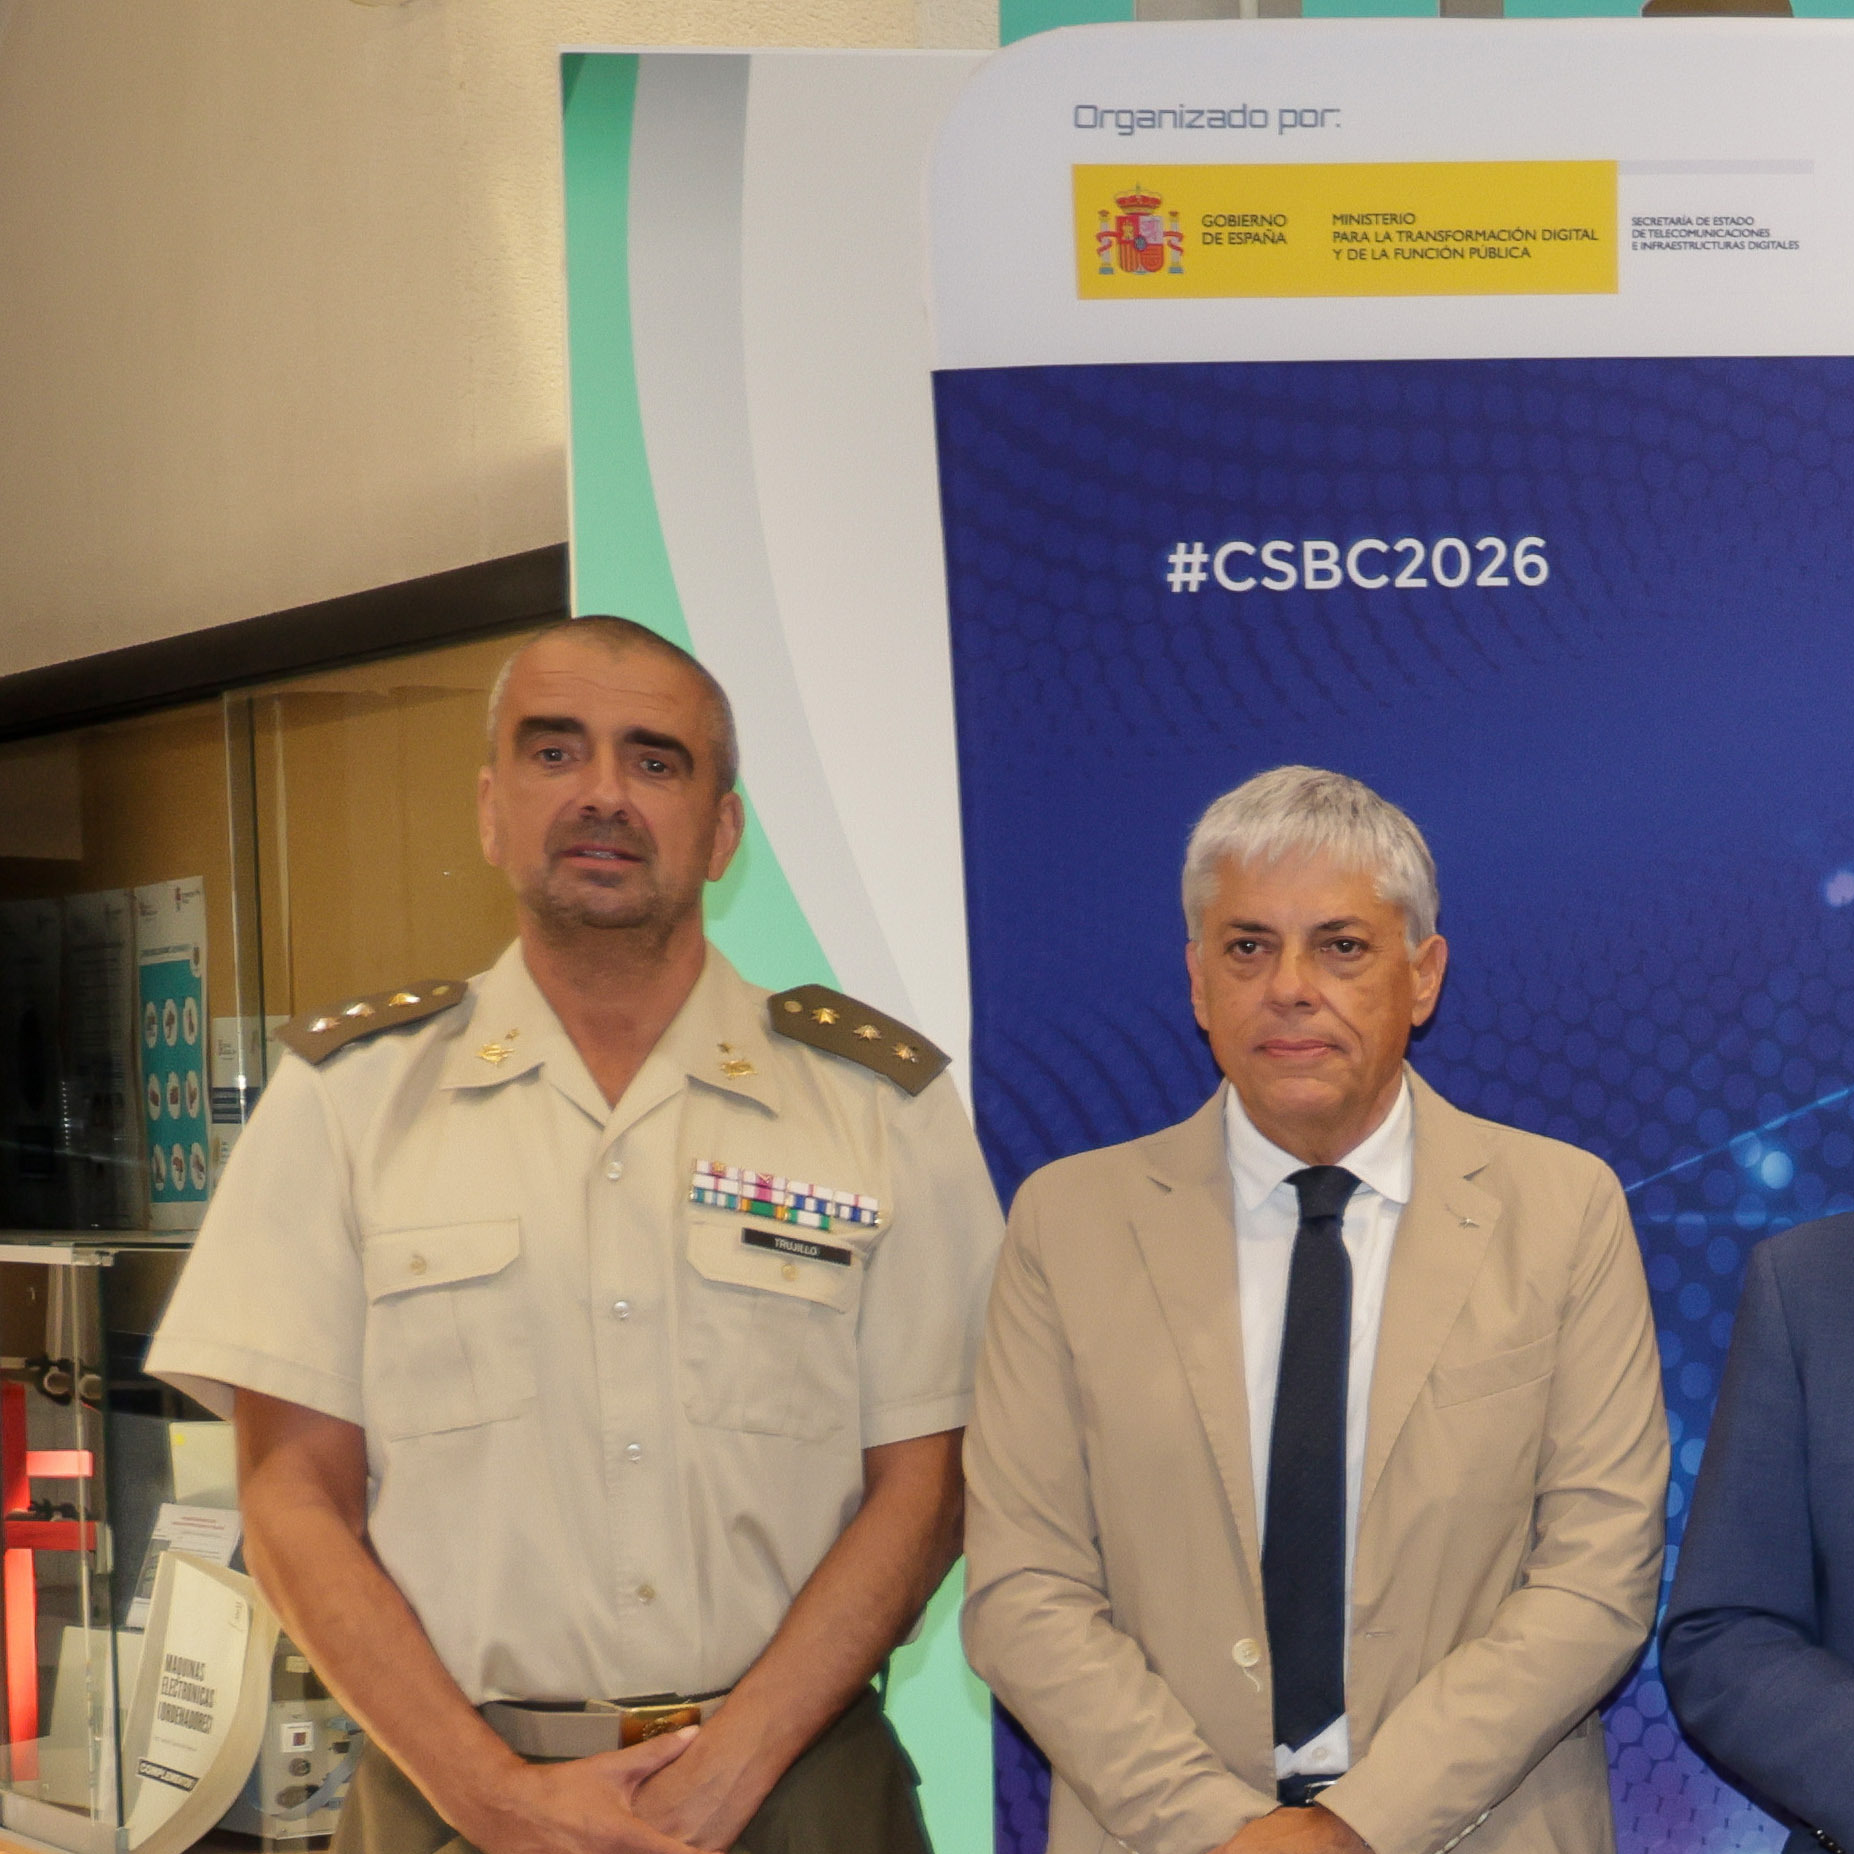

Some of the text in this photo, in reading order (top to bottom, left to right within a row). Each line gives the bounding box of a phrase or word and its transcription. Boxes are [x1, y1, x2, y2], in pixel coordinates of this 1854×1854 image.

[1073, 103, 1342, 137] Organizado por:
[1200, 213, 1288, 229] GOBIERNO
[1332, 212, 1416, 226] MINISTERIO
[1631, 214, 1755, 227] SECRETARÍA DE ESTADO
[1201, 228, 1288, 246] DE ESPAÑA
[1332, 226, 1600, 244] PARA LA TRANSFORMACIÓN DIGITAL
[1631, 228, 1771, 239] DE TELECOMUNICACIONES
[1333, 243, 1532, 261] Y DE LA FUNCIÓN PÚBLICA
[1640, 240, 1746, 251] INFRAESTRUCTURAS
[1747, 240, 1800, 250] DIGITALES
[1167, 535, 1550, 593] #CSBC2026
[774, 1237, 818, 1256] TRUJILLO
